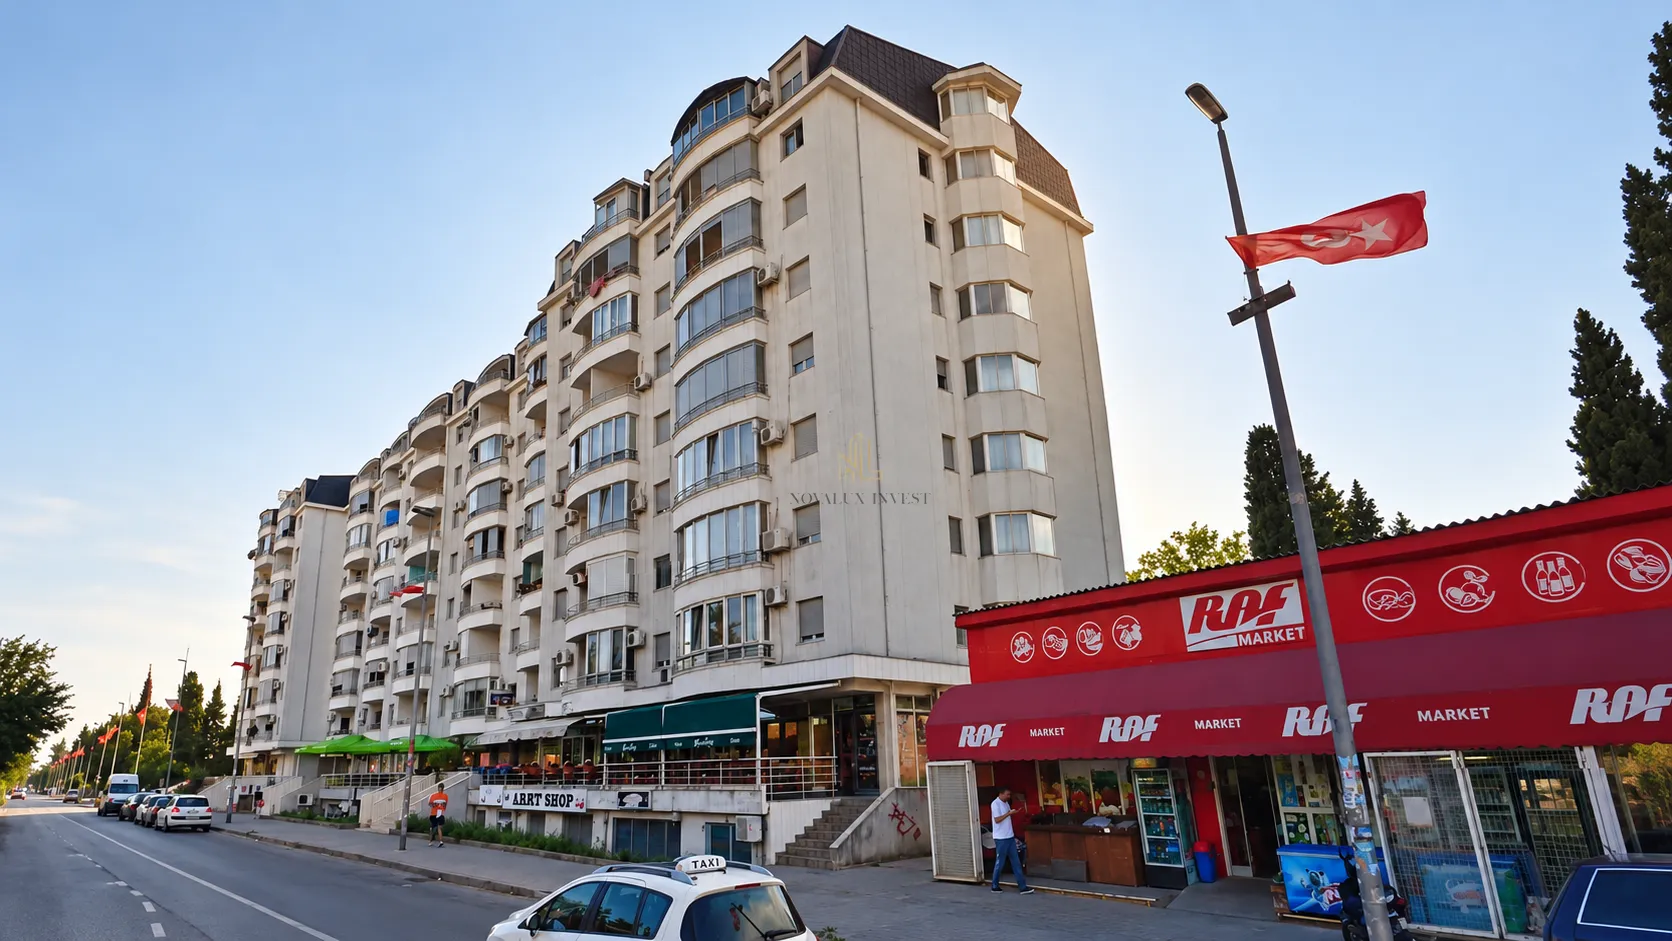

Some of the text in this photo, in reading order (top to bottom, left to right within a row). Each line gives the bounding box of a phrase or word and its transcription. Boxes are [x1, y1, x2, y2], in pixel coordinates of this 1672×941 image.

[1187, 582, 1294, 635] RAF
[1238, 626, 1305, 647] MARKET
[958, 723, 1007, 748] RAF
[1029, 727, 1065, 737] MARKET
[1098, 714, 1162, 743] RAF
[1194, 718, 1242, 730] MARKET
[1416, 706, 1491, 722] MARKET
[1569, 683, 1672, 725] RAF
[544, 793, 574, 808] SHOP
[691, 858, 720, 869] TAXI
